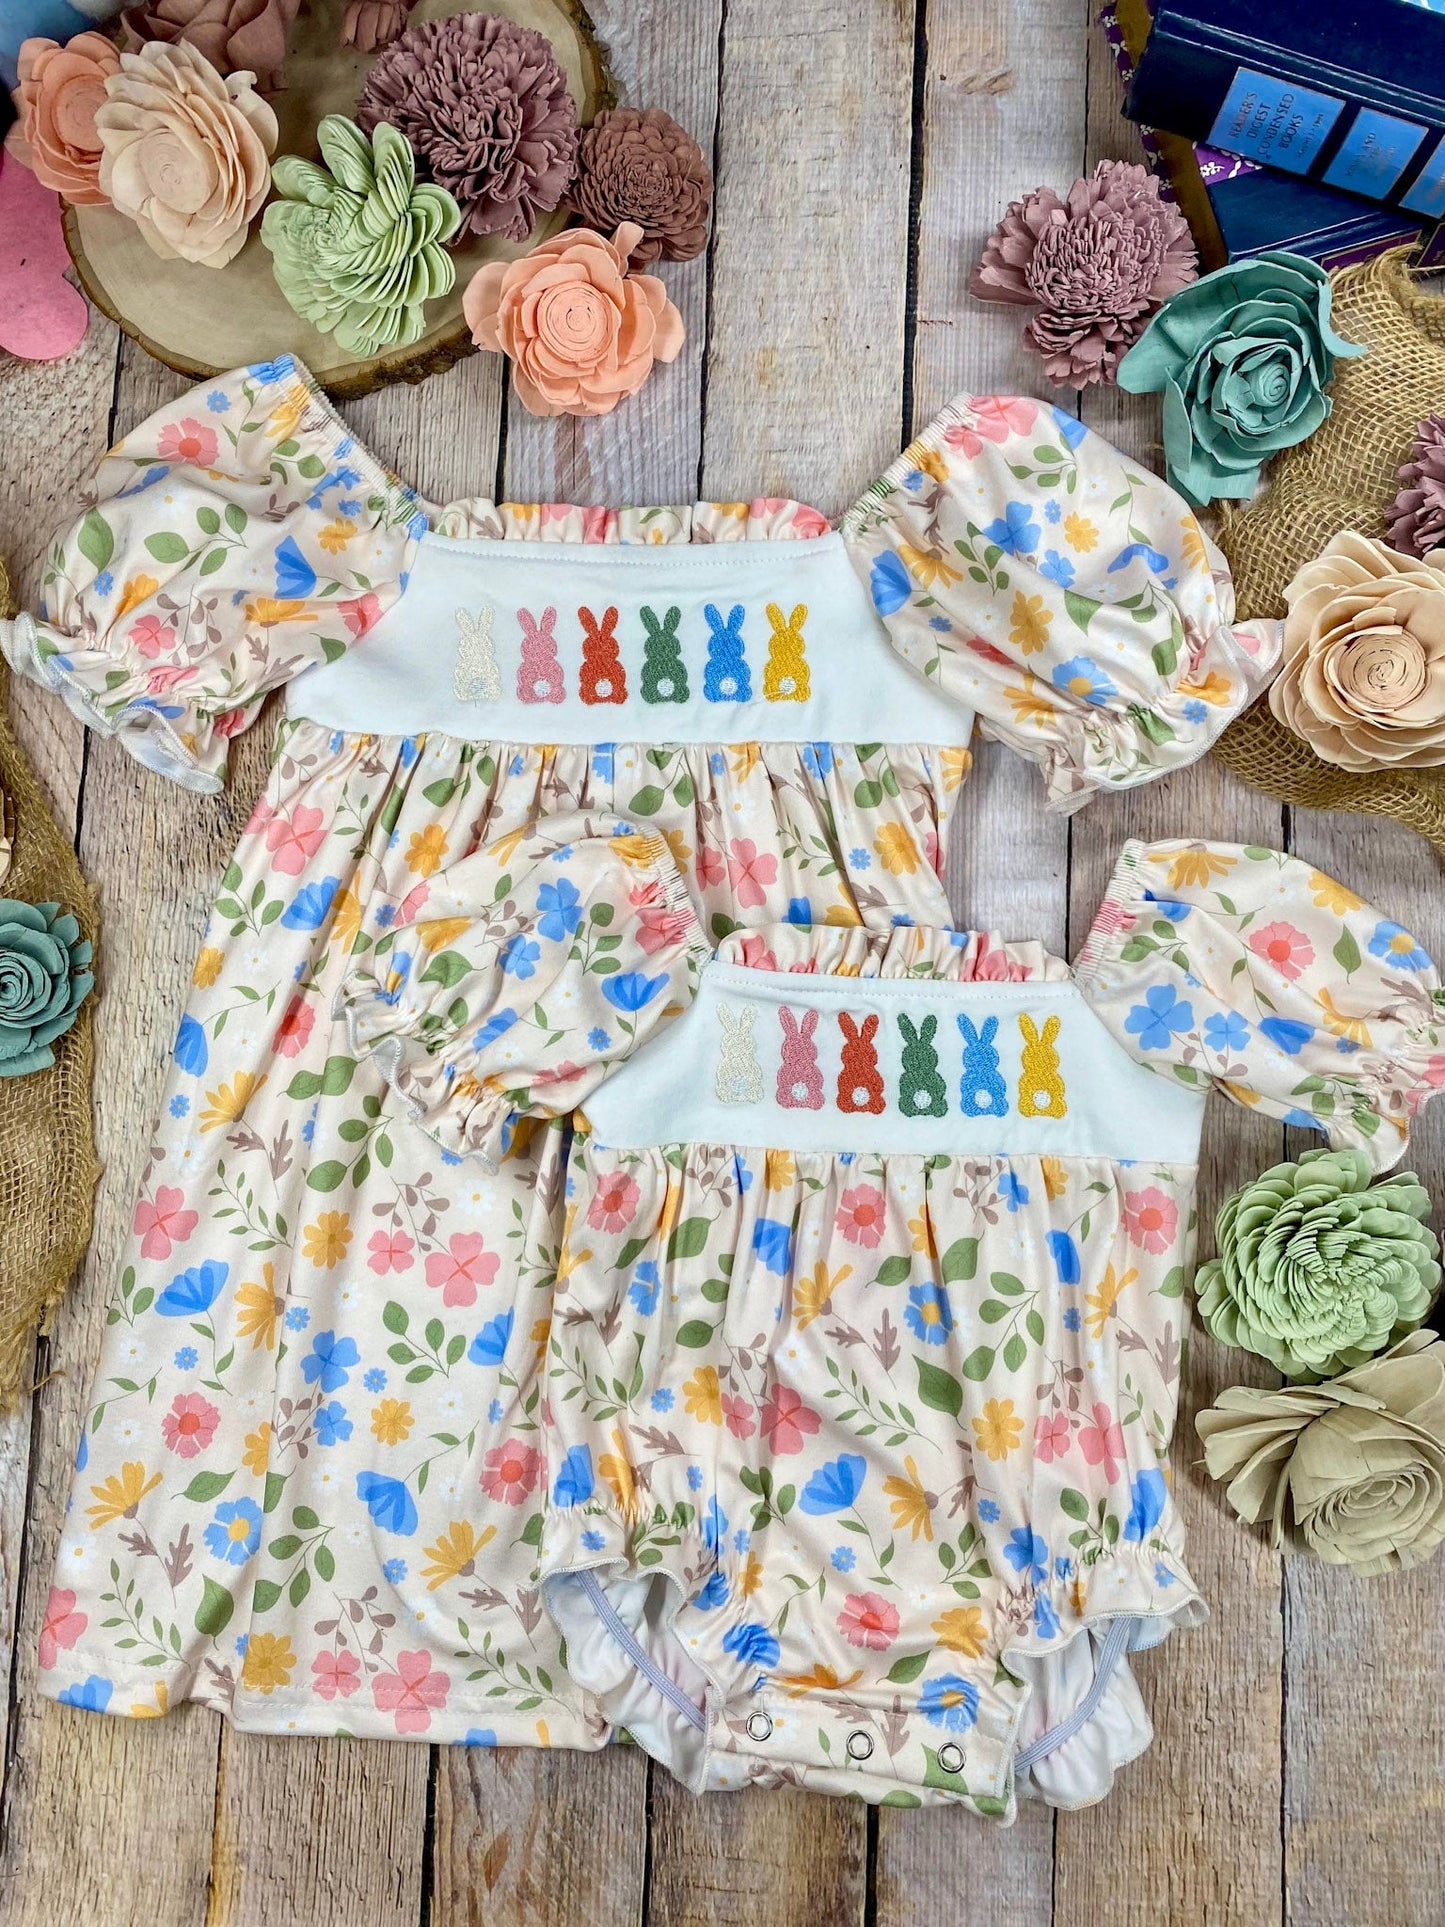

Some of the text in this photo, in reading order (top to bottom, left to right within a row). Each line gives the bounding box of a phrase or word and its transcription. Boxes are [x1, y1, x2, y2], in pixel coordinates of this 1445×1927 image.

[1246, 102, 1271, 139] DIGEST
[1257, 93, 1295, 155] CONDENSED
[1279, 114, 1304, 149] BOOKS
